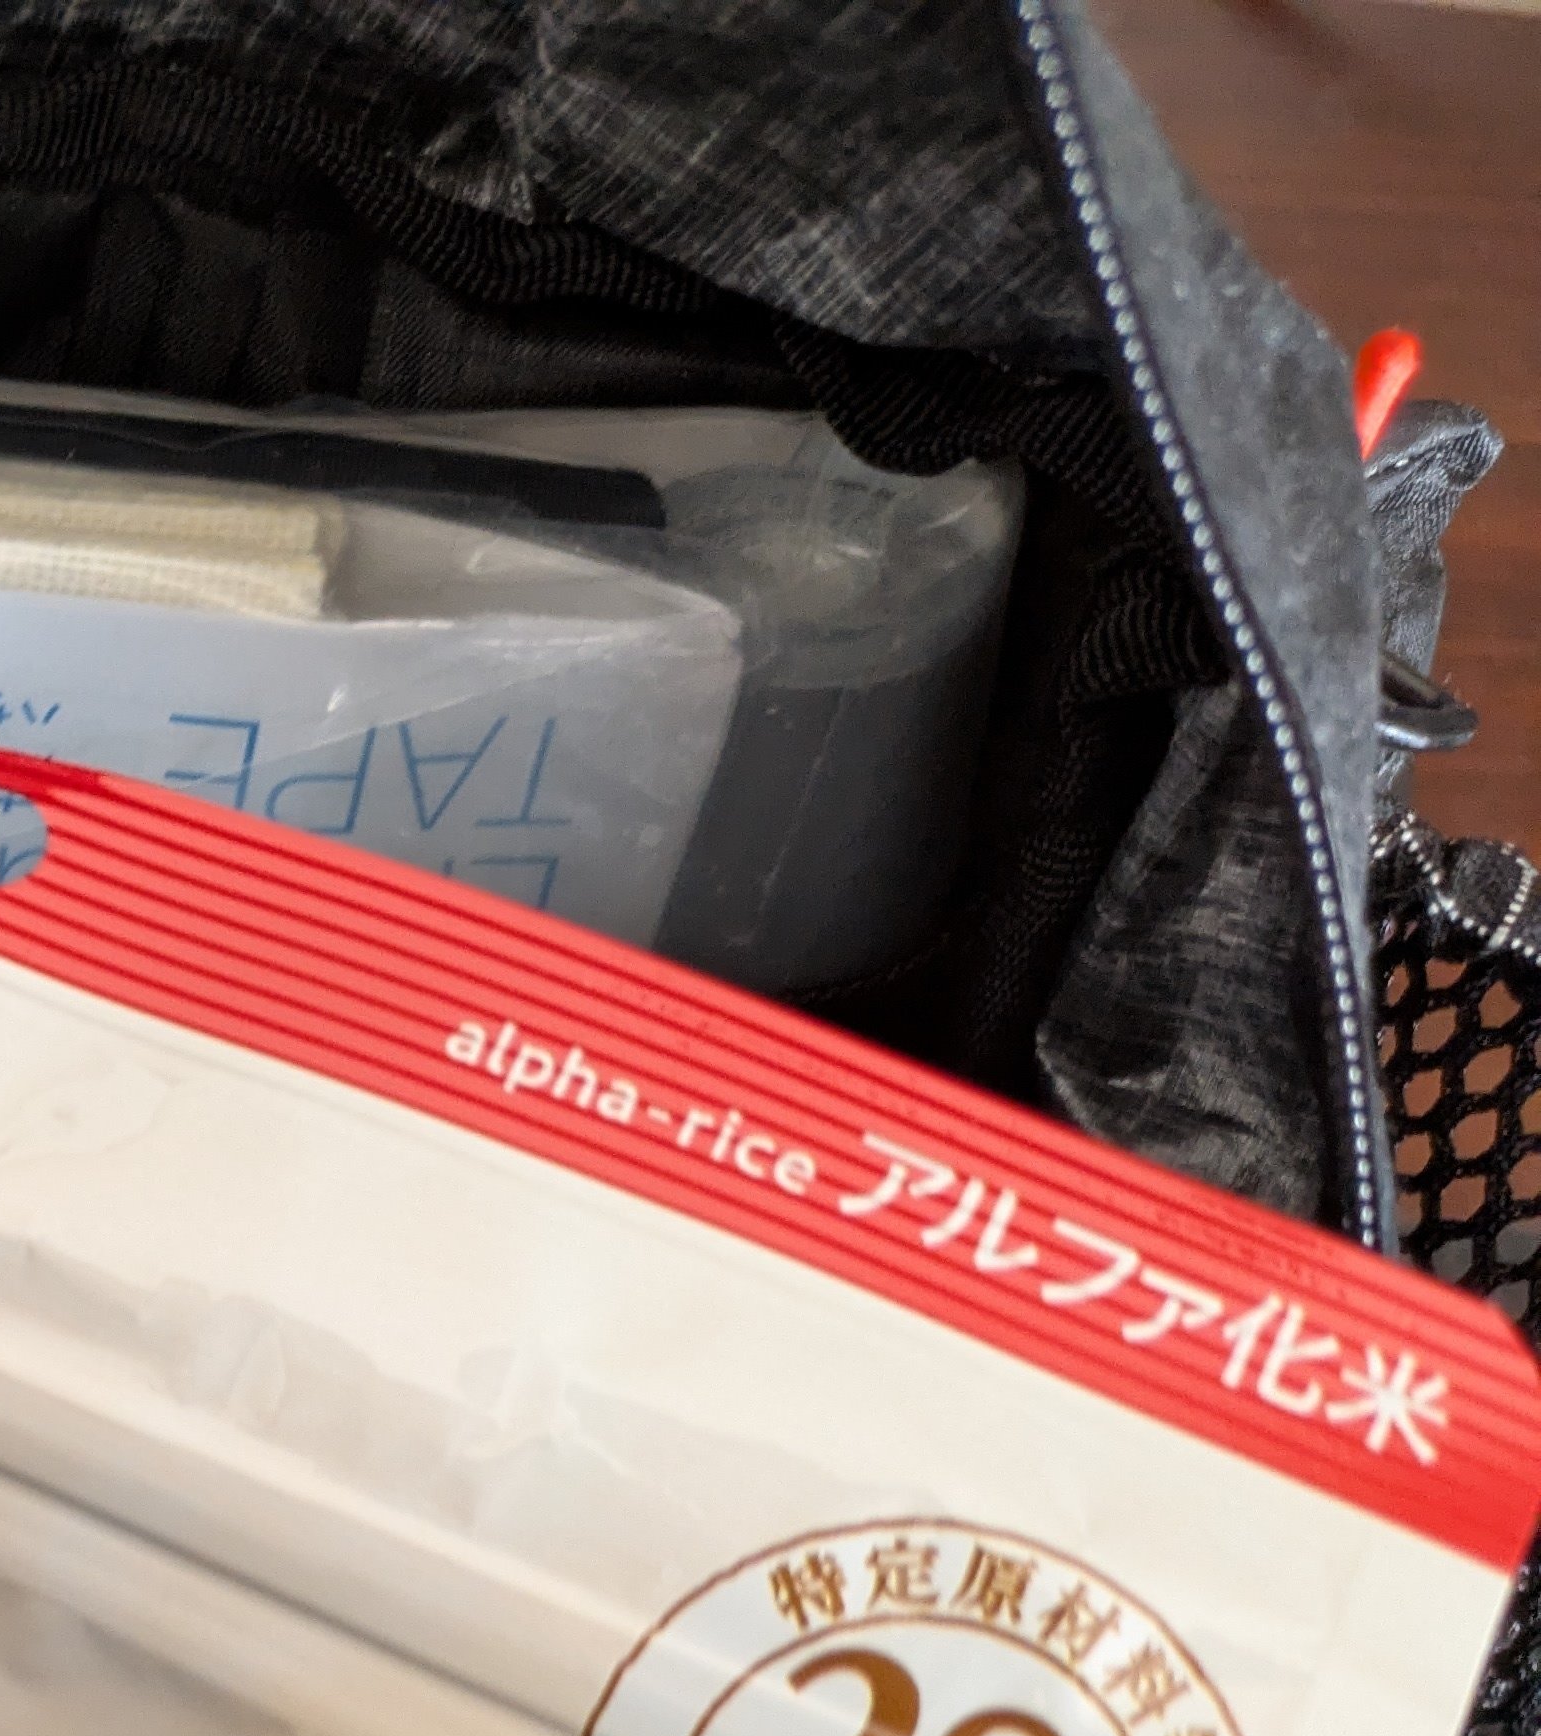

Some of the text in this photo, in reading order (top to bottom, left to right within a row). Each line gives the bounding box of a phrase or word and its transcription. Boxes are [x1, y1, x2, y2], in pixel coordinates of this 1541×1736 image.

[163, 711, 573, 838] TAPE
[444, 1020, 1450, 1466] alpha-rice アルファ化米
